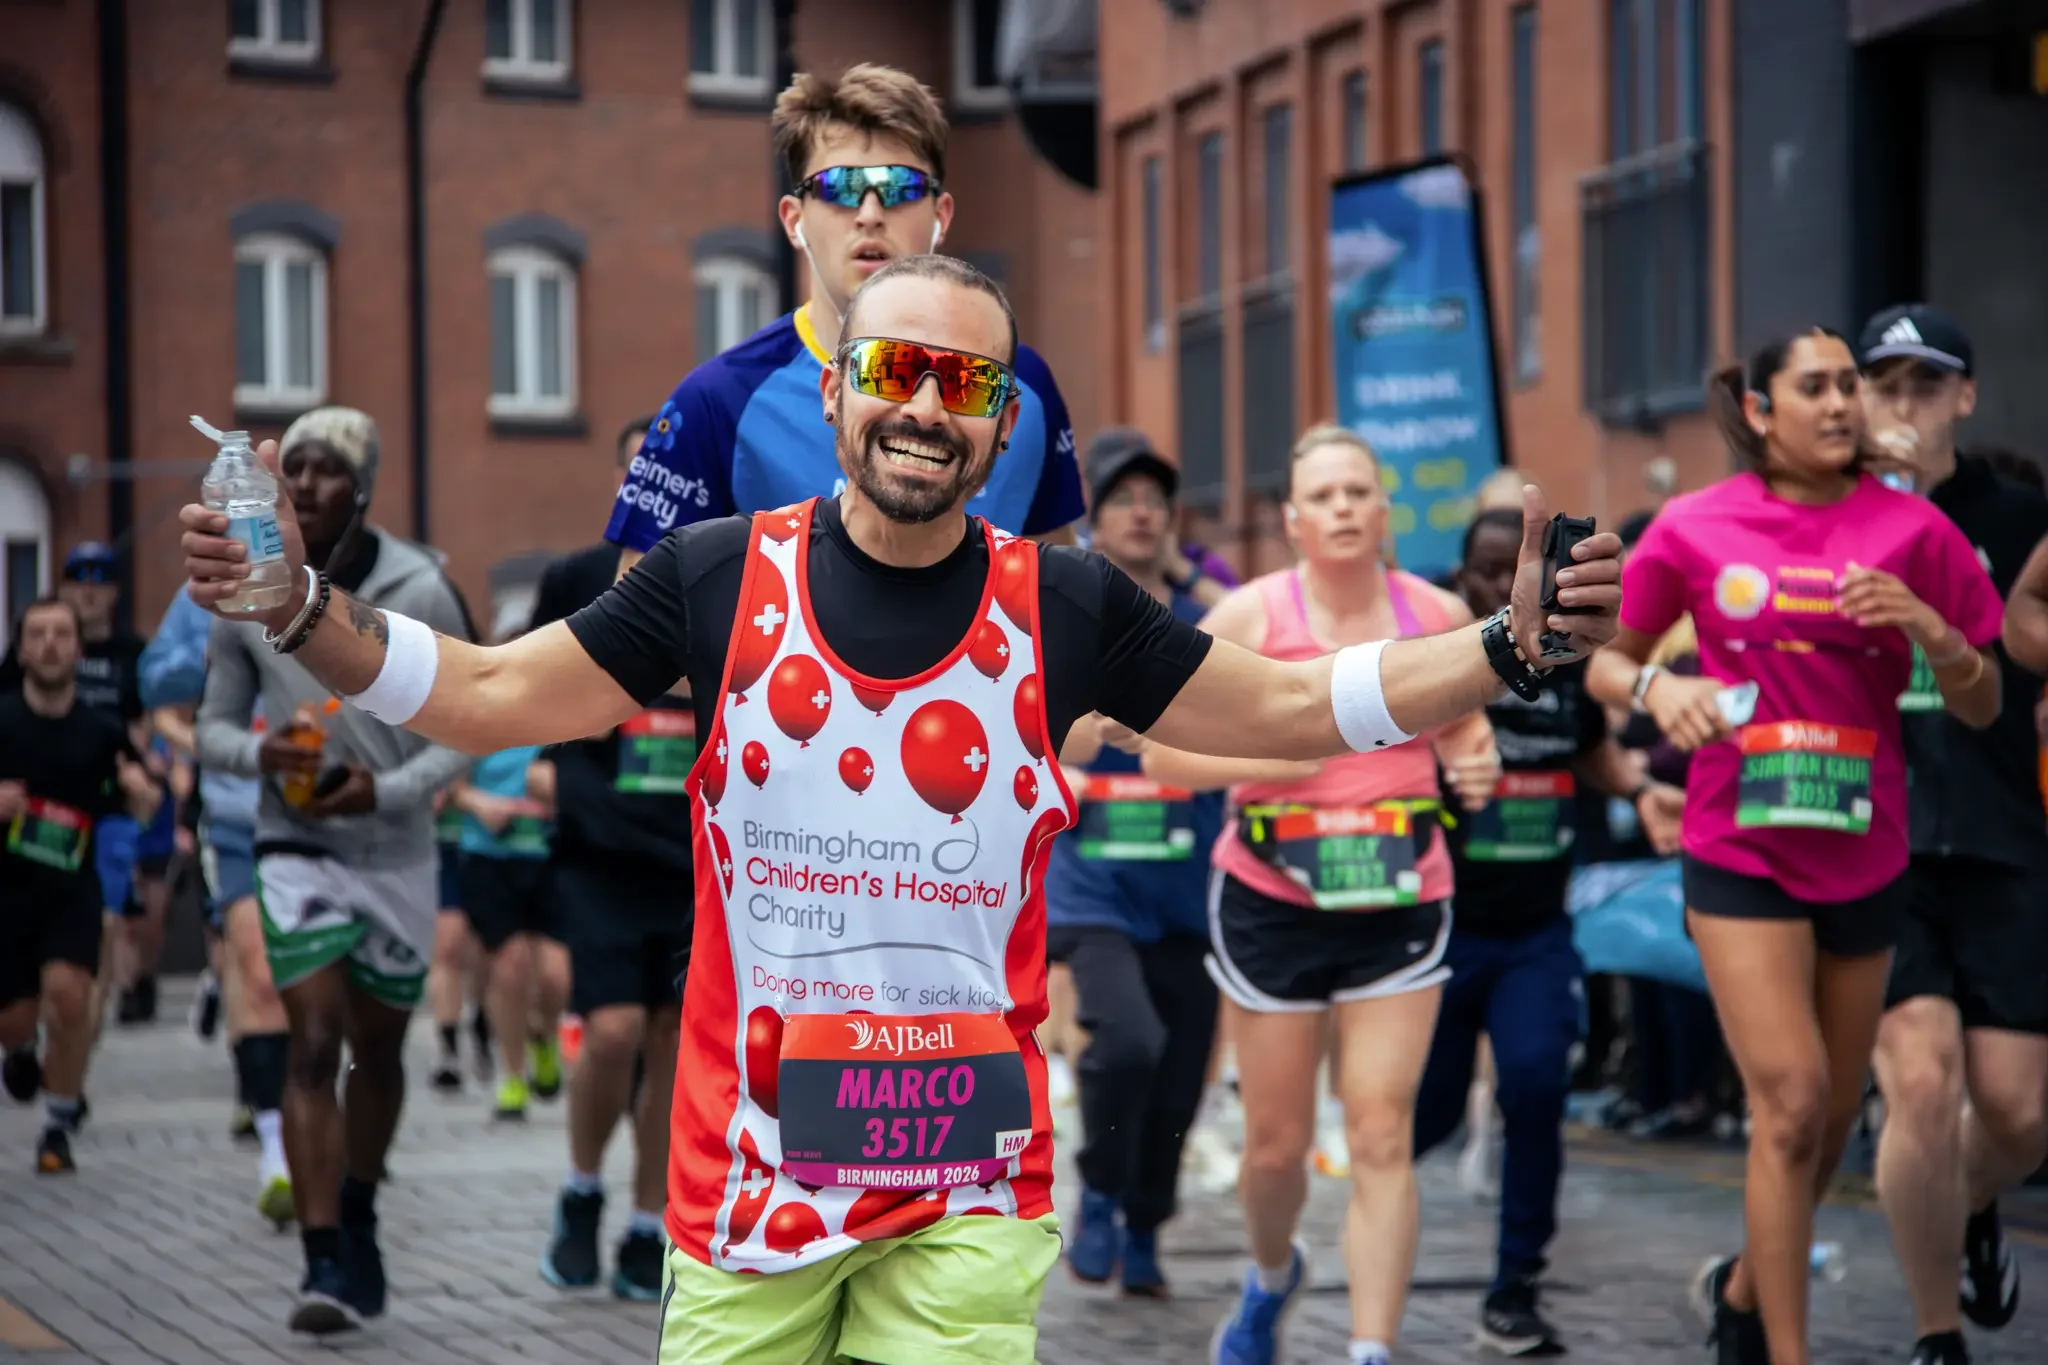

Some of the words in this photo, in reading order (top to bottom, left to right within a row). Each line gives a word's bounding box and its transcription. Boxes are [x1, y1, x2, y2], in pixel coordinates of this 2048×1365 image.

[743, 820, 921, 864] Birmingham
[746, 857, 883, 898] Children's
[894, 871, 1007, 911] Hospital
[748, 893, 845, 938] Charity
[753, 965, 807, 1000] Doing
[813, 981, 874, 1001] more
[880, 981, 911, 1003] for
[919, 984, 960, 1006] sick
[835, 1064, 975, 1109] MARCO
[861, 1115, 955, 1158] 3517
[1003, 1135, 1025, 1152] HM
[837, 1167, 938, 1187] BIRMINGHAM
[943, 1165, 980, 1184] 2026
